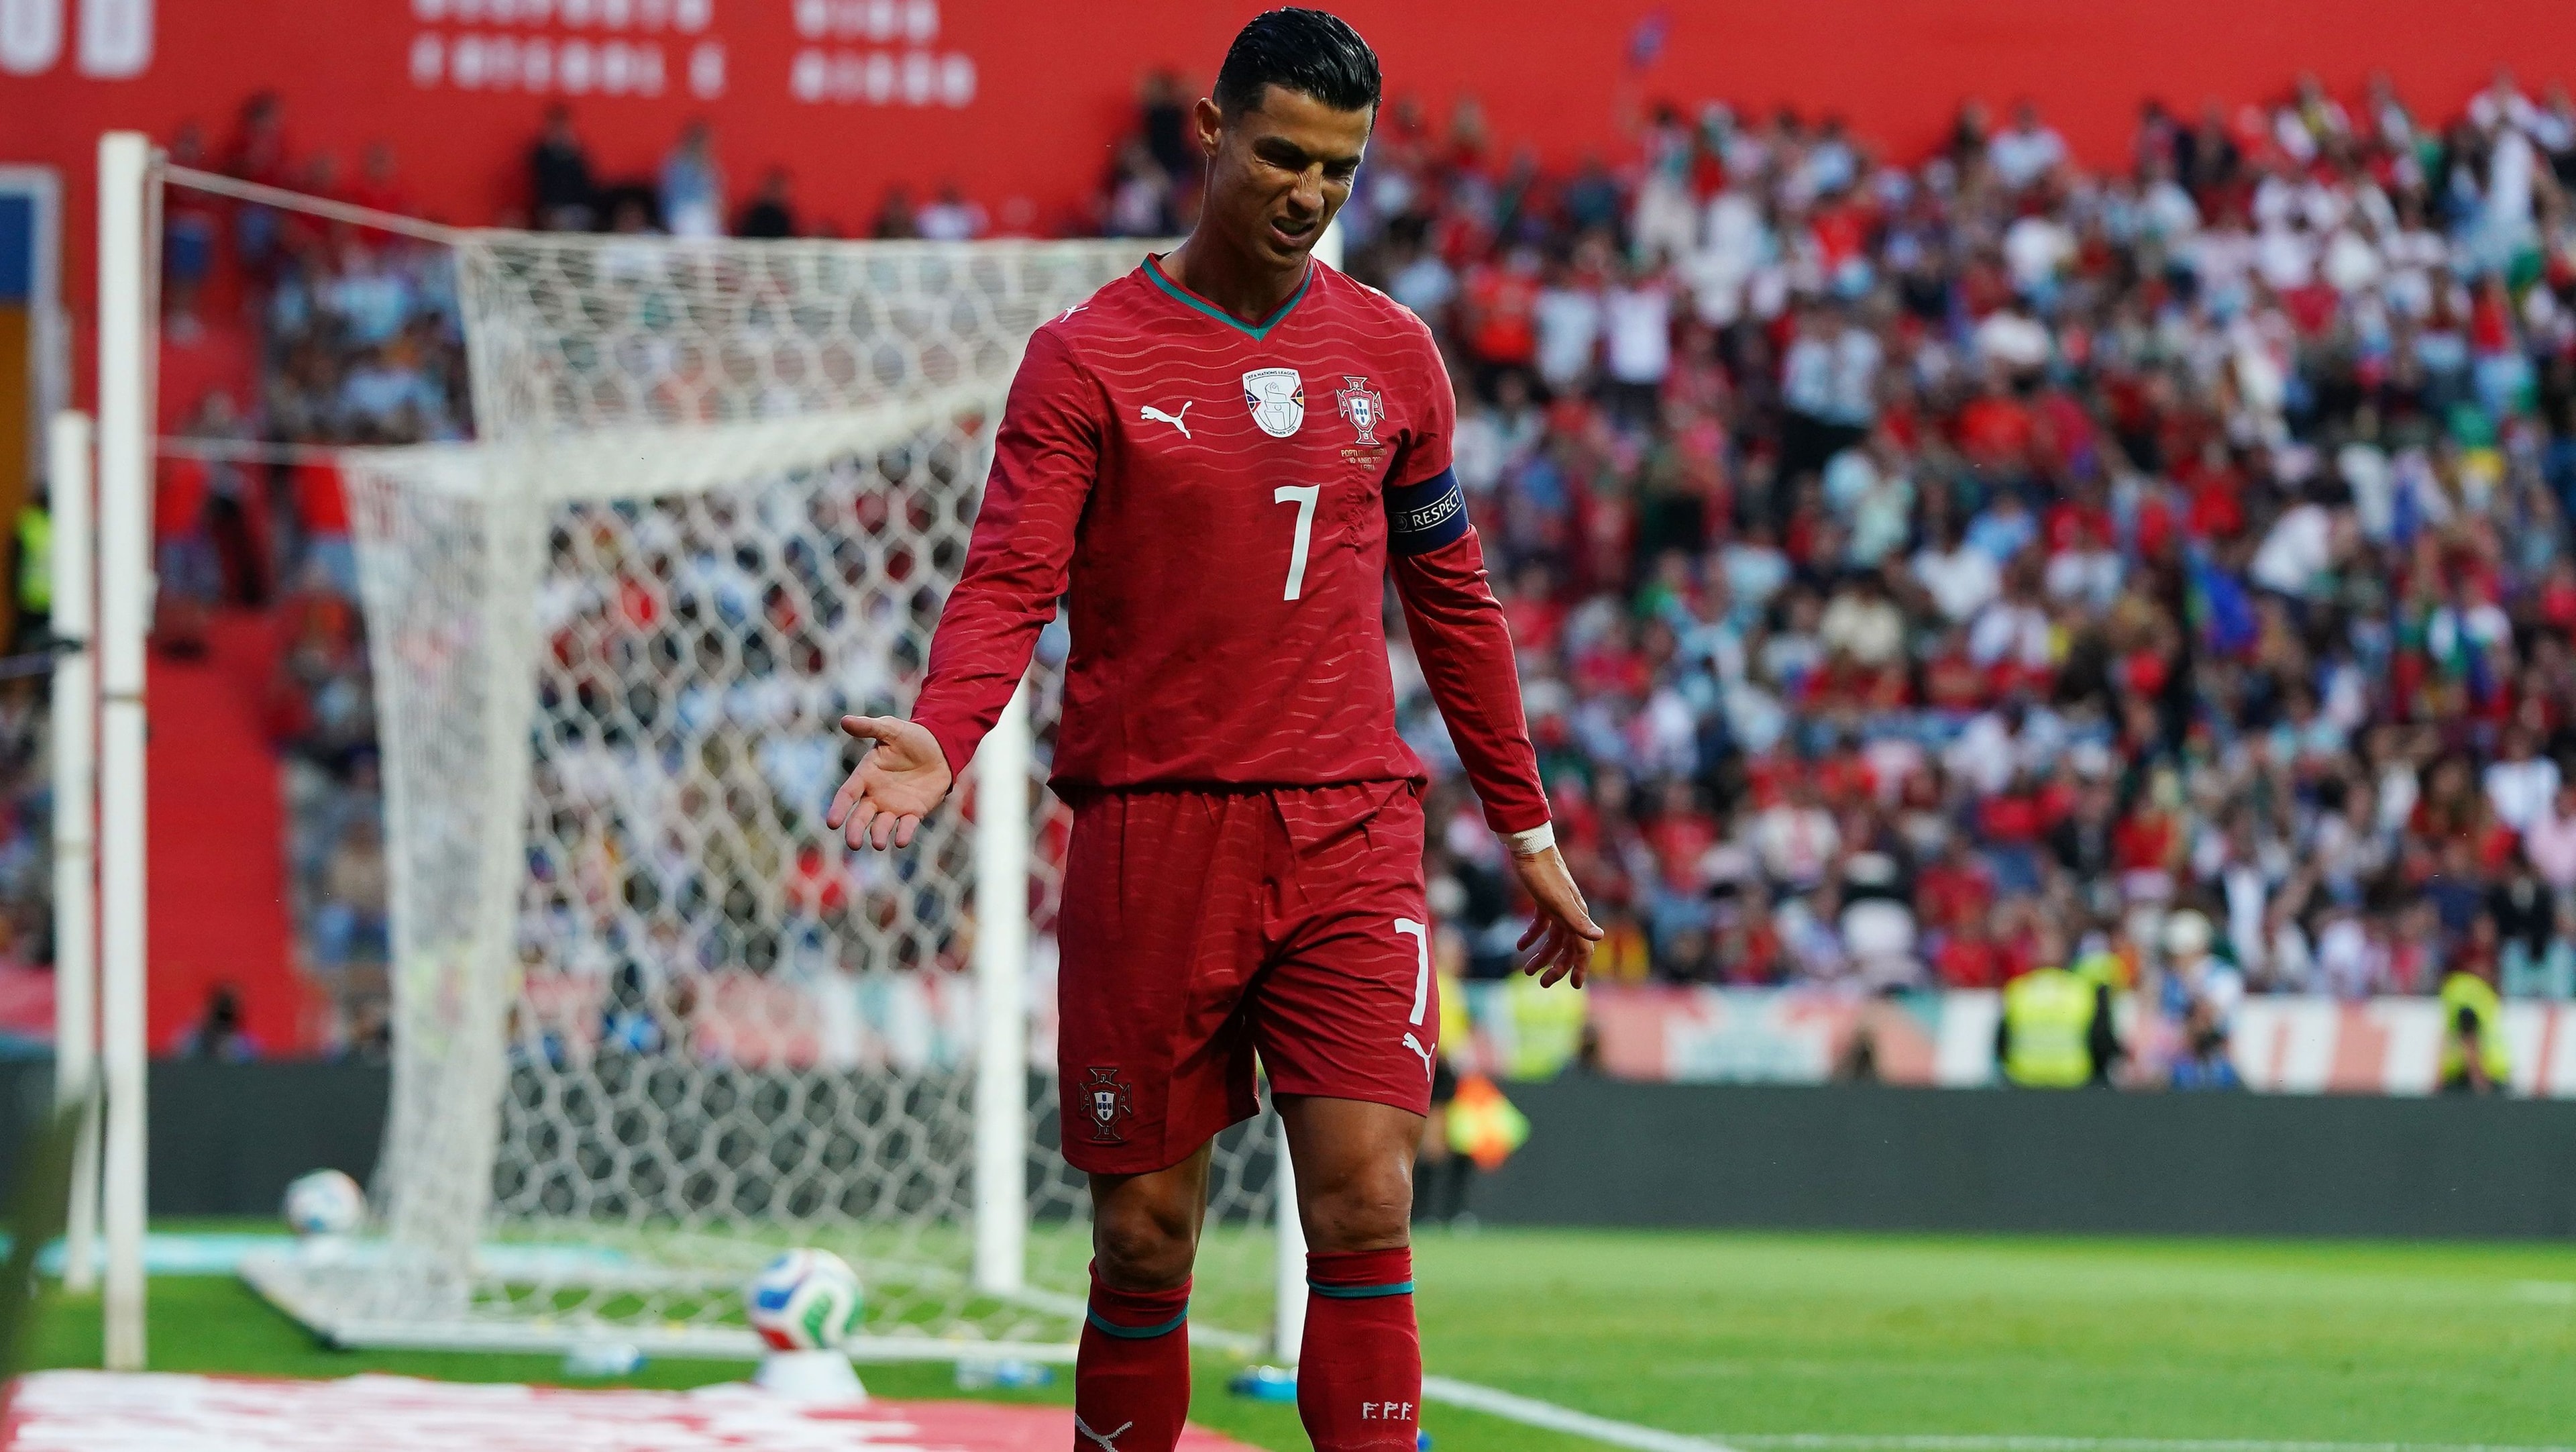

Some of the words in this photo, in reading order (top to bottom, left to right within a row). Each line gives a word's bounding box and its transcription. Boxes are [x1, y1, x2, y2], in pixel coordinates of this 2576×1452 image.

[1274, 484, 1320, 601] 7
[1412, 490, 1460, 527] RESPECT
[1394, 918, 1429, 1027] 7
